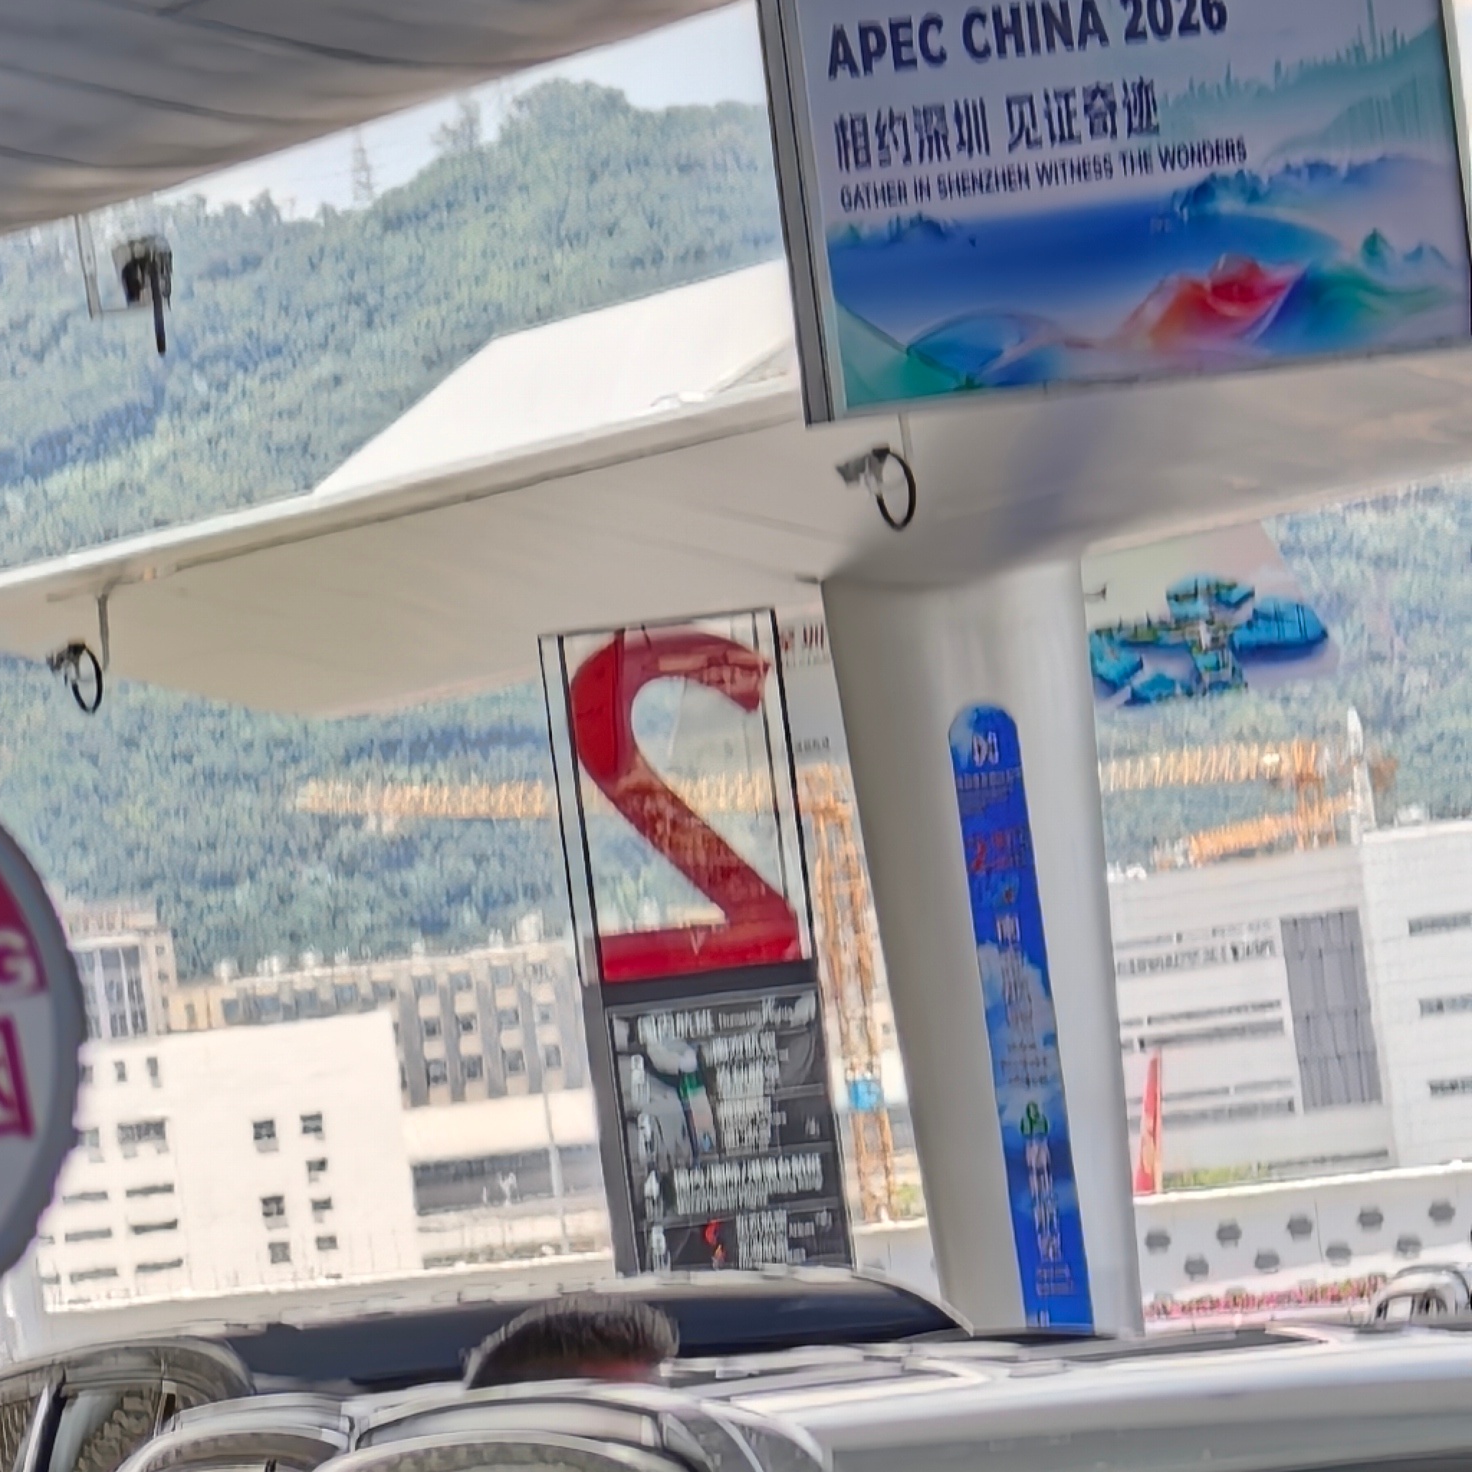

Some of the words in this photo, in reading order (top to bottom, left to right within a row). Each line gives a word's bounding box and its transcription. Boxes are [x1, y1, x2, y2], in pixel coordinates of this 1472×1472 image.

[827, 12, 948, 80] APEC
[834, 96, 992, 174] 相约深圳
[1005, 75, 1161, 154] 见证奇迹
[840, 178, 909, 214] GATHER
[913, 174, 932, 204] IN
[937, 161, 1032, 201] SHENZHEN
[1035, 151, 1114, 188] WITNESS
[1119, 144, 1154, 178] THE
[1157, 135, 1248, 174] WONDERS
